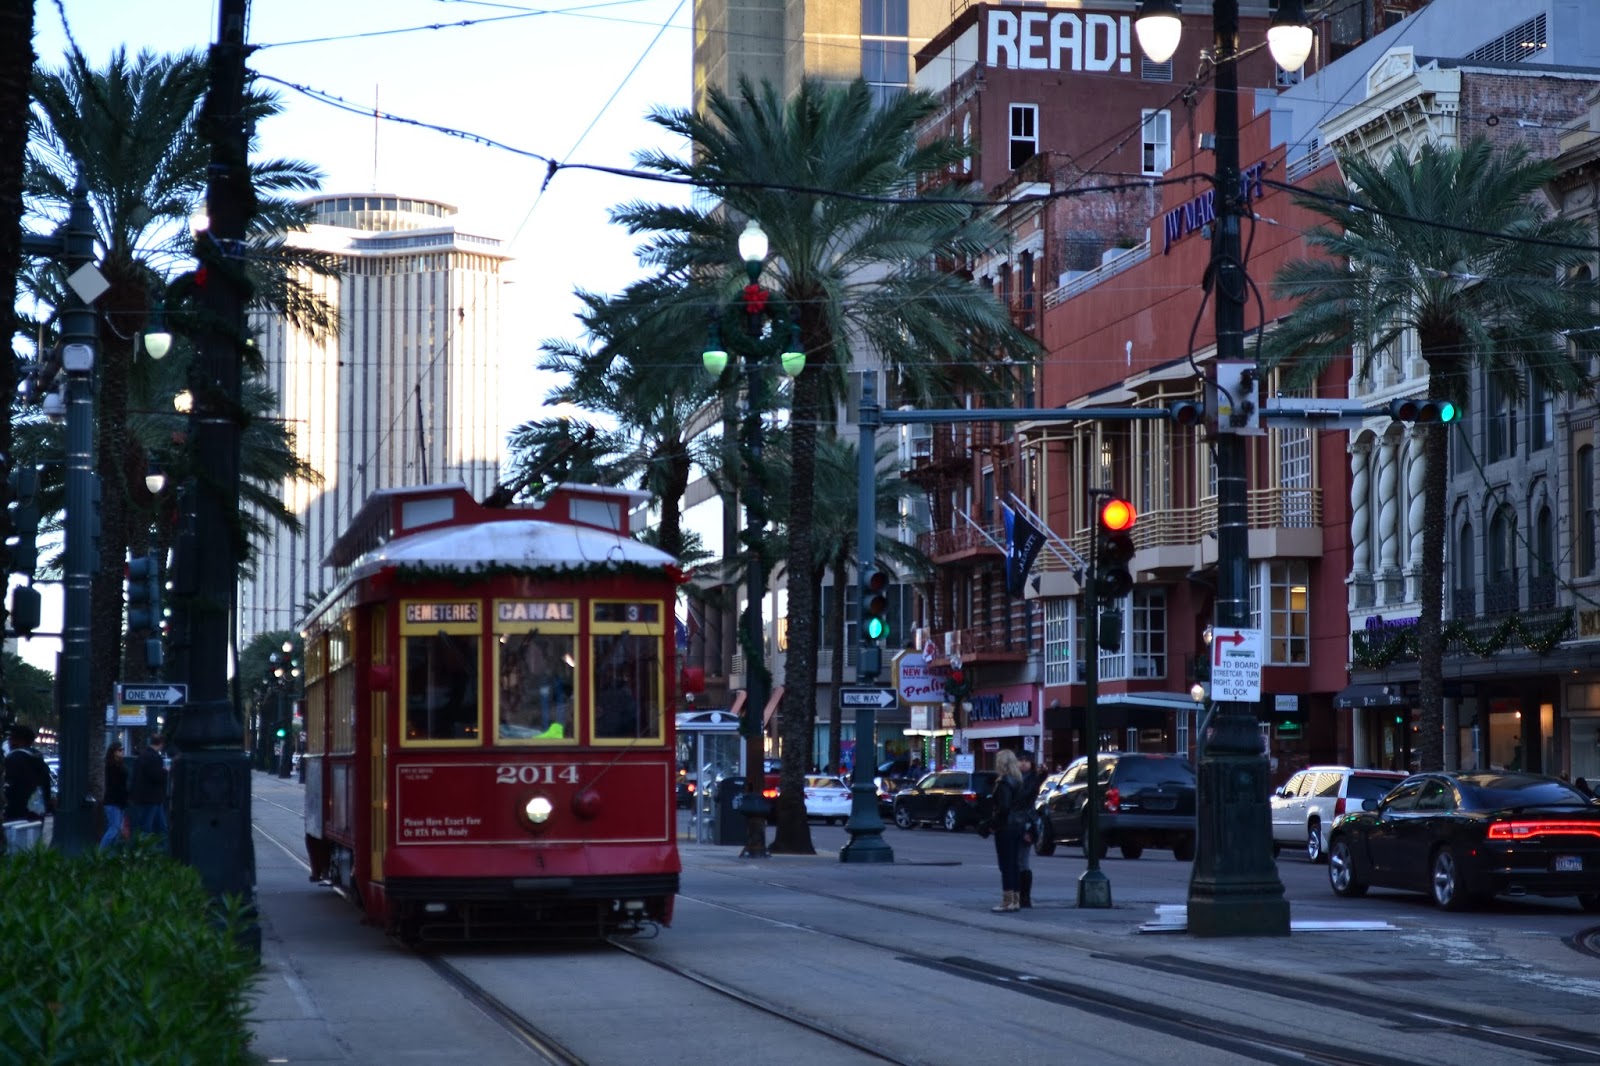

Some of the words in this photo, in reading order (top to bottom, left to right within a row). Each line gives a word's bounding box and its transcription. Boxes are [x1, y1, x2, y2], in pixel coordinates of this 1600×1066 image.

[986, 10, 1132, 72] READ!
[1163, 205, 1184, 256] JW
[1184, 161, 1267, 234] MARTT
[406, 604, 478, 621] CEMETERIES
[499, 603, 573, 620] CANAL
[628, 605, 639, 621] 3
[1235, 661, 1259, 669] BOARD
[902, 668, 920, 677] NEW
[1247, 680, 1259, 688] ONE
[128, 691, 146, 700] ONE
[148, 691, 167, 700] WAY
[1223, 688, 1248, 696] BLOCK
[845, 694, 861, 703] ONE
[863, 694, 880, 703] WAY
[1001, 700, 1030, 718] EMPORIUM
[496, 765, 579, 784] 2014
[403, 818, 424, 827] Please
[426, 817, 442, 826] Have
[444, 817, 464, 826] Exact
[466, 816, 481, 825] Fare
[403, 828, 412, 837] Or
[415, 828, 429, 837] RTA
[431, 827, 446, 836] Pass
[448, 827, 468, 837] Ready
